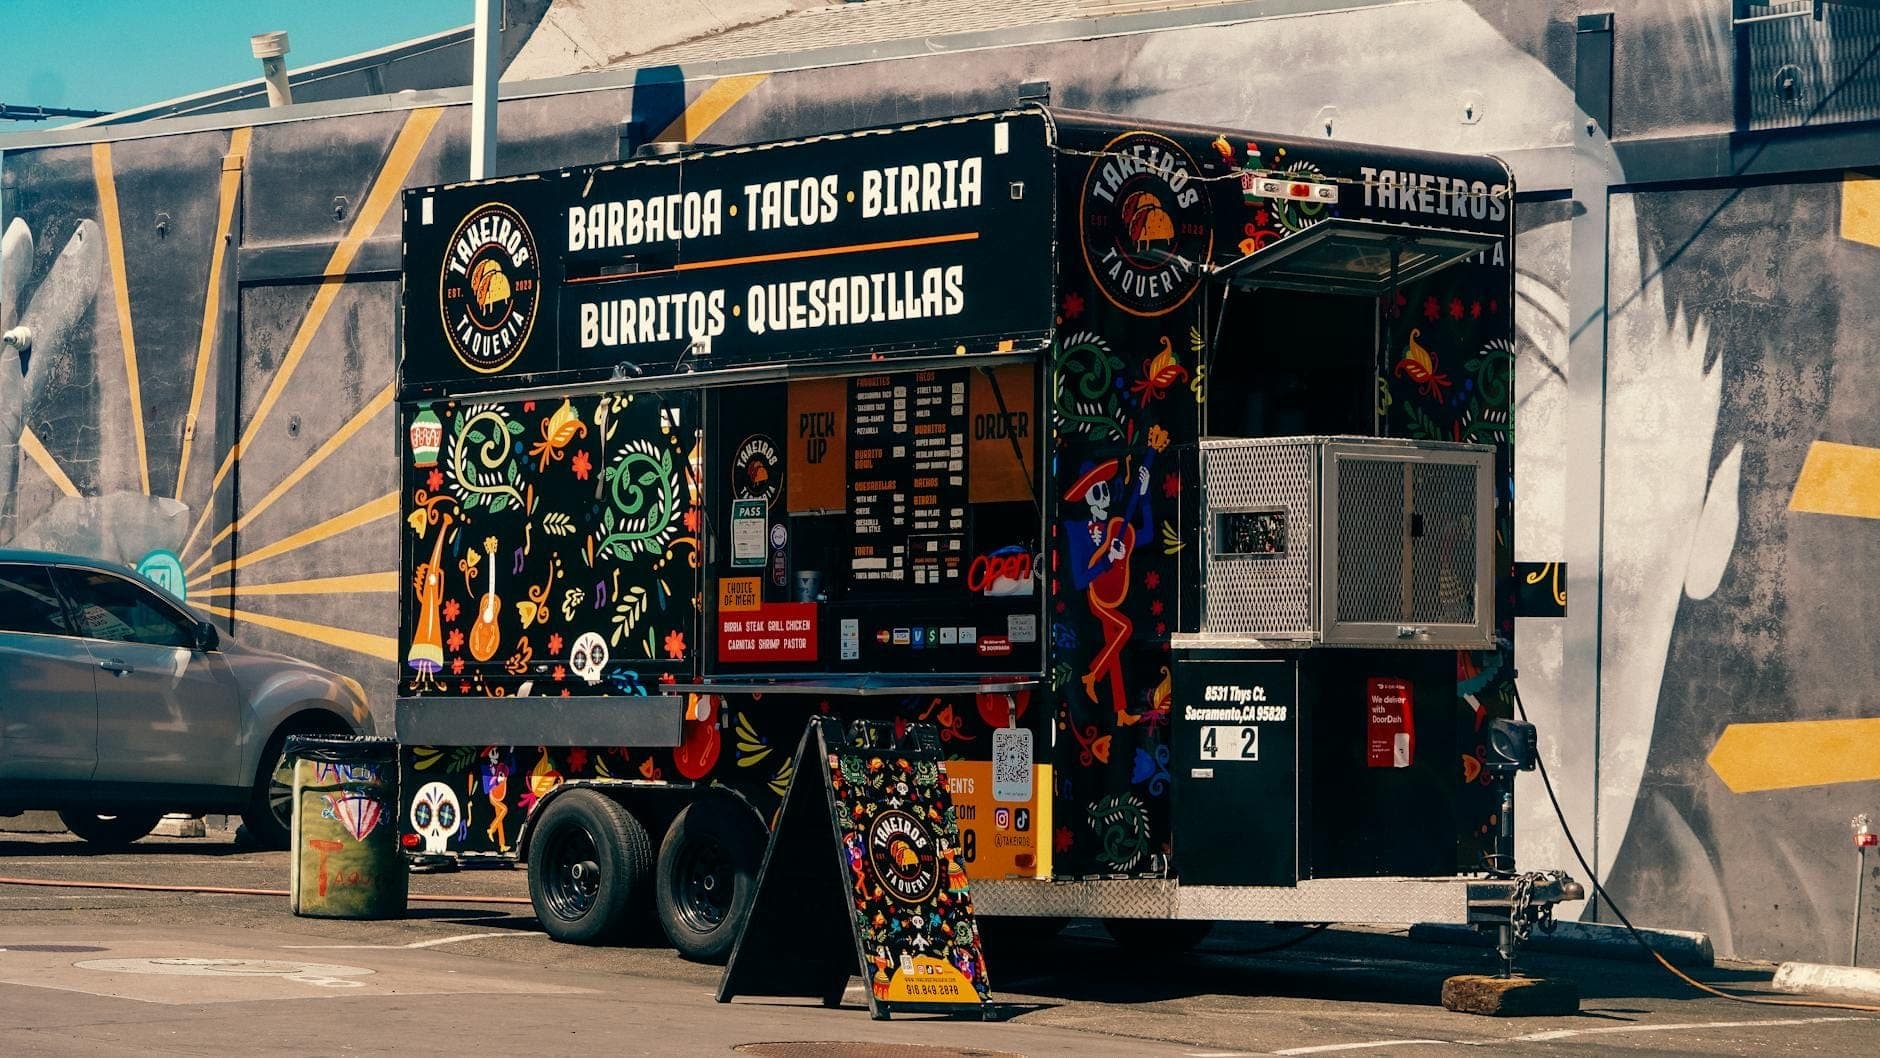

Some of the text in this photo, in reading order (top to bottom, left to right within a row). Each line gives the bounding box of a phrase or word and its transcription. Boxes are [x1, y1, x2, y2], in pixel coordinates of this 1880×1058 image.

[1093, 145, 1199, 209] TAKEIROS
[568, 156, 983, 252] BARBACOA TACOS BIRRIA
[1360, 166, 1506, 222] TAKEIROS
[450, 216, 530, 276] TAKEIROS
[1102, 247, 1193, 298] TAQUERIA
[447, 288, 464, 299] EST.
[515, 280, 533, 292] 2023
[580, 266, 964, 349] BURRITOS QUESADILLAS
[456, 311, 525, 357] TAQUERIA
[800, 411, 835, 438] PICK
[975, 411, 1029, 440] ORDER
[736, 439, 778, 469] TAKEIROS
[807, 438, 827, 464] UP
[739, 506, 761, 517] PASS
[724, 594, 755, 606] OF MEAT
[728, 582, 752, 594] CHOICE
[724, 619, 811, 632] BIRRIA STEAK GRILL CHICKEN
[728, 638, 807, 650] CARNITAS SHRIMP PASTOR
[1204, 685, 1267, 706] 8531 Thys Ct.
[1371, 695, 1406, 704] We deliver
[1256, 705, 1288, 722] 95828
[1371, 706, 1386, 714] with
[1372, 715, 1402, 724] DoorDash
[1203, 727, 1256, 758] 4 2
[949, 778, 975, 794] ENTS
[874, 817, 928, 849] TAKEIROS
[885, 869, 932, 894] TAQUERIA
